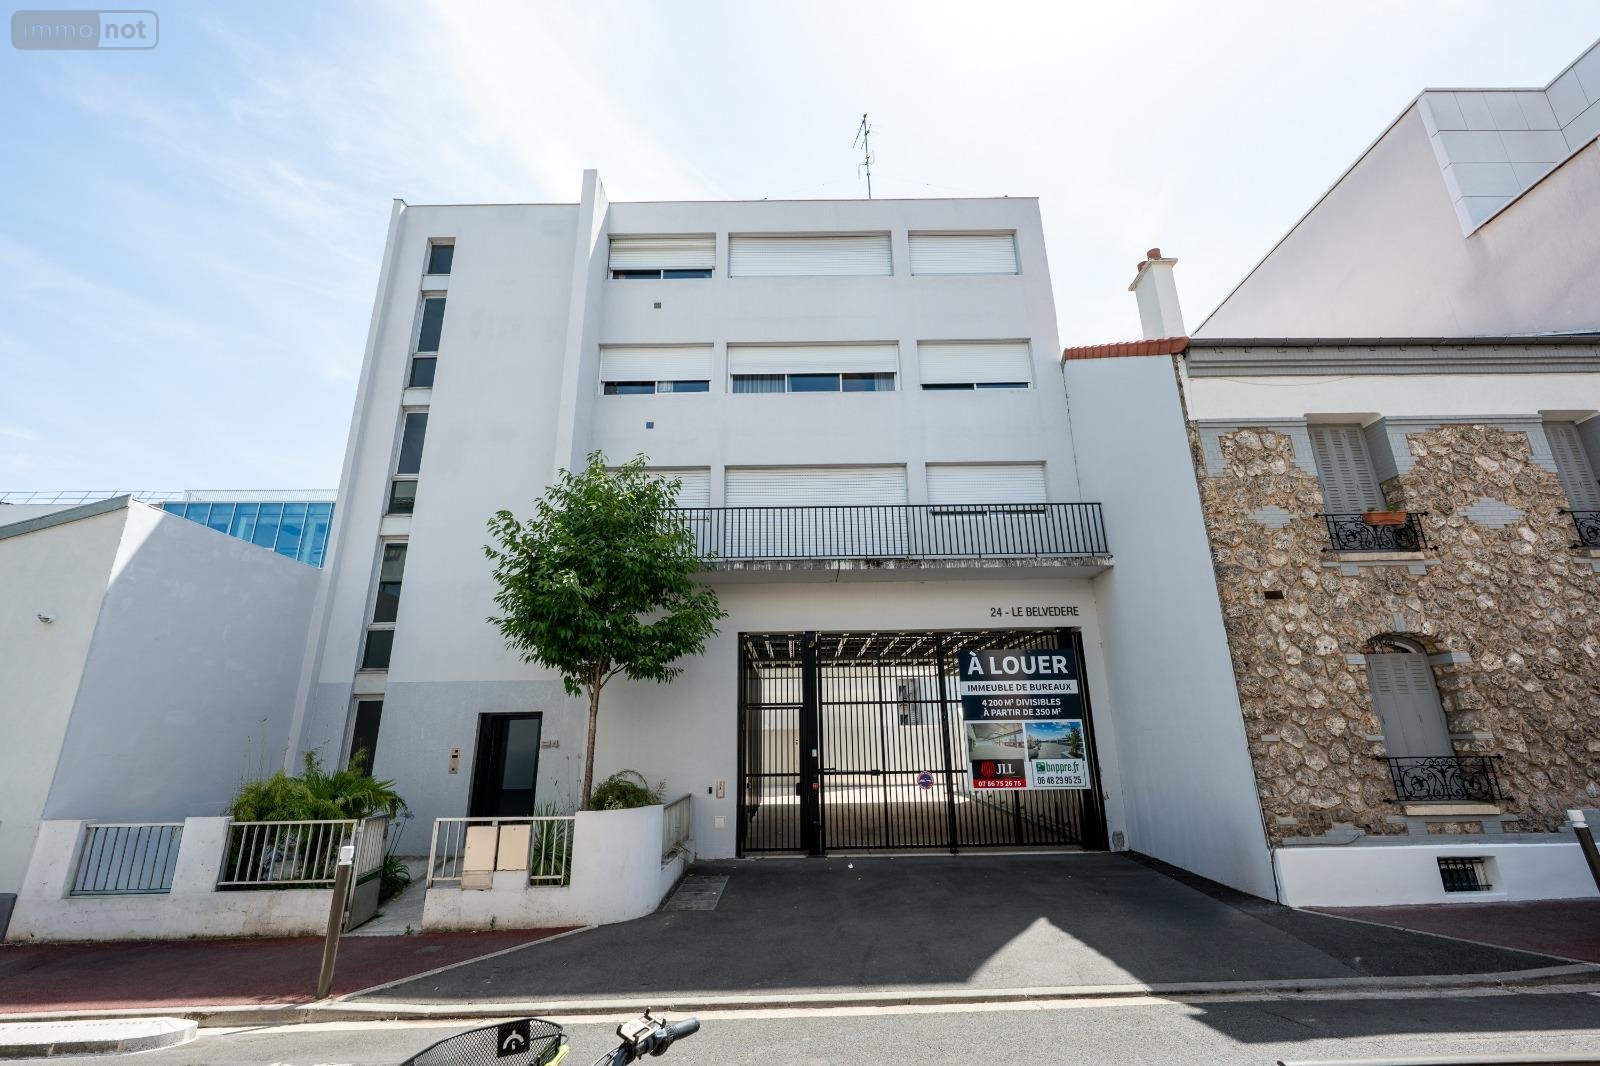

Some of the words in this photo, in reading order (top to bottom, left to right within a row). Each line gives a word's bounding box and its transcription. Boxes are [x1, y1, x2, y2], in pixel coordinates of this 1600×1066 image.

[990, 607, 1002, 618] 24
[1011, 607, 1023, 617] LE
[1026, 606, 1079, 617] BELVEDERE
[967, 650, 984, 675] À
[989, 655, 1069, 675] LOUER
[967, 683, 1014, 692] IMMEUBLE
[1016, 683, 1028, 691] DE
[1030, 683, 1072, 691] BUREAUX
[1015, 698, 1061, 706] DIVISIBLES
[983, 707, 990, 717] À
[991, 708, 1021, 717] PARTIR
[1022, 708, 1034, 716] DE
[1035, 708, 1050, 716] 350
[996, 763, 1016, 775] JLL
[1046, 762, 1079, 774] bnppre.fr
